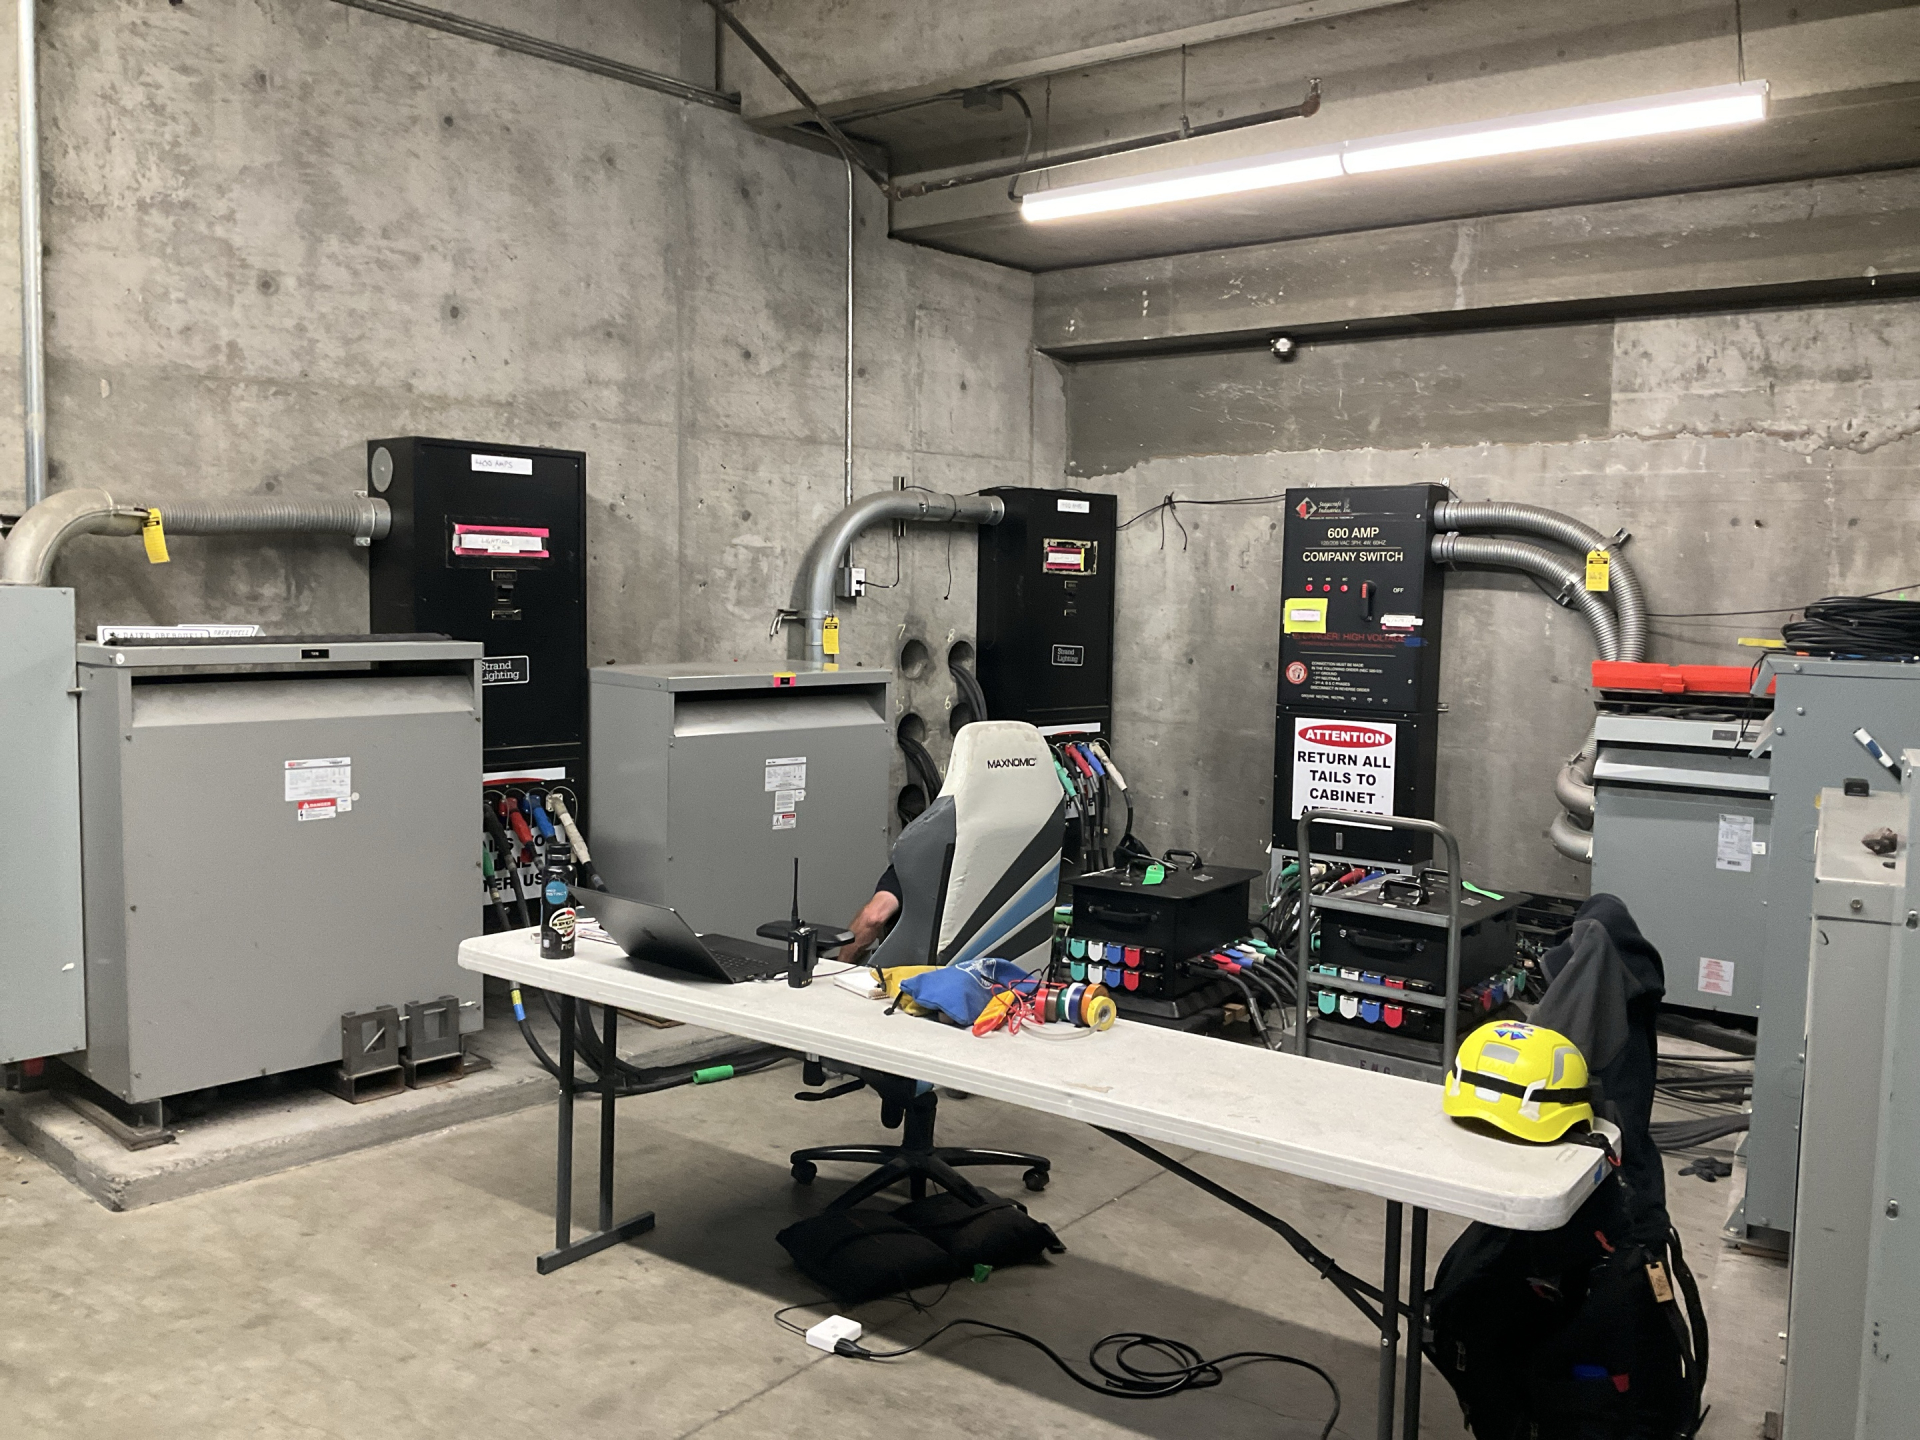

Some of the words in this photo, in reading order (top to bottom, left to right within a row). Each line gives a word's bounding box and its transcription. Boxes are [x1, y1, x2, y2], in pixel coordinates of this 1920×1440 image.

[475, 459, 492, 467] 400
[1327, 528, 1349, 538] 600
[1351, 527, 1379, 538] AMP
[1302, 551, 1357, 562] COMPANY
[1359, 551, 1404, 562] SWITCH
[898, 624, 906, 640] 7
[947, 628, 955, 643] 8
[1343, 632, 1365, 641] HIGH
[482, 660, 511, 670] Strand
[1057, 655, 1078, 663] Lighting
[944, 695, 951, 710] 6
[1305, 729, 1385, 744] ATTENTION
[987, 757, 1036, 769] MAXNOMIC
[1297, 750, 1357, 766] RETURN
[1362, 755, 1391, 768] ALL
[1309, 769, 1351, 784] TAILS
[1356, 773, 1377, 786] TO
[1309, 788, 1376, 804] CABINET
